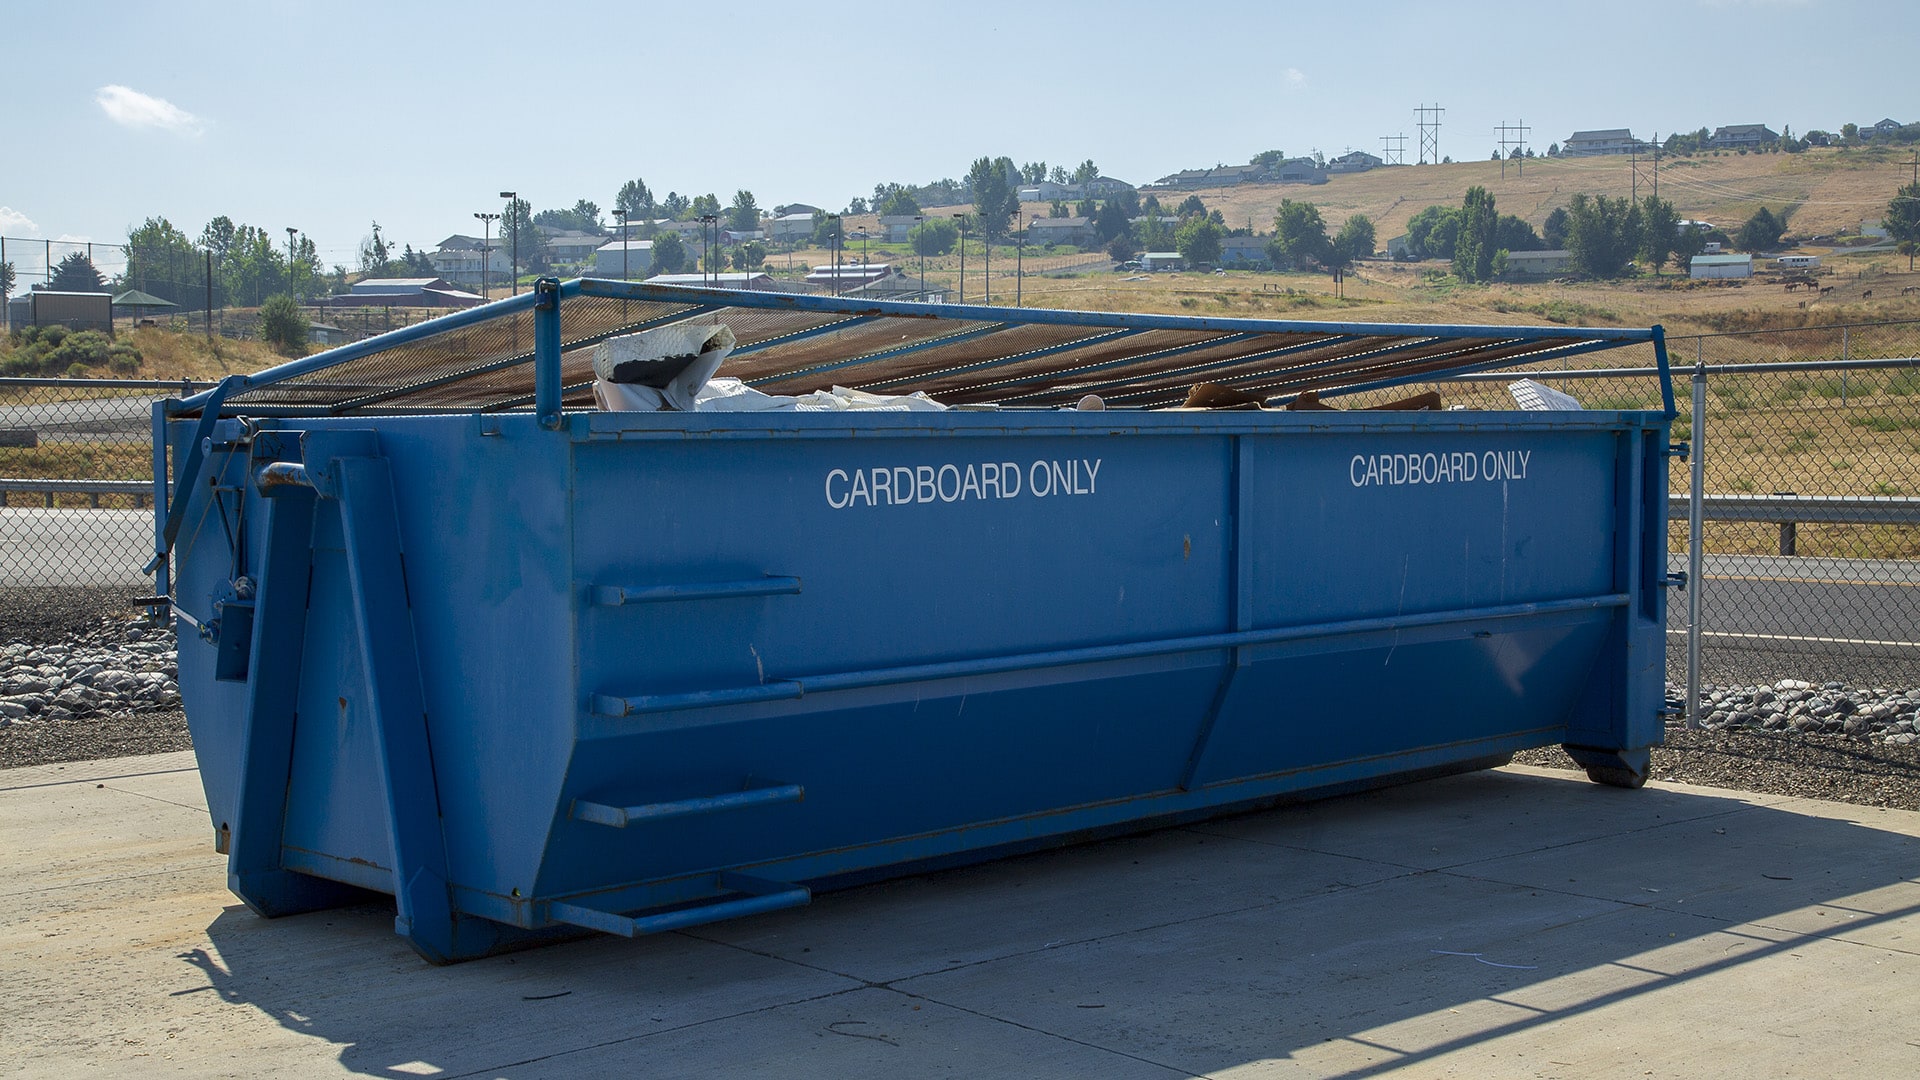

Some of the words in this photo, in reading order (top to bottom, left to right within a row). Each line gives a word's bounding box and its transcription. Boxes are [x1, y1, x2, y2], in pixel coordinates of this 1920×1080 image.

[825, 462, 1022, 509] CARDBOARD
[1029, 458, 1102, 497] ONLY
[1350, 452, 1478, 487] CARDBOARD
[1482, 450, 1531, 481] ONLY
